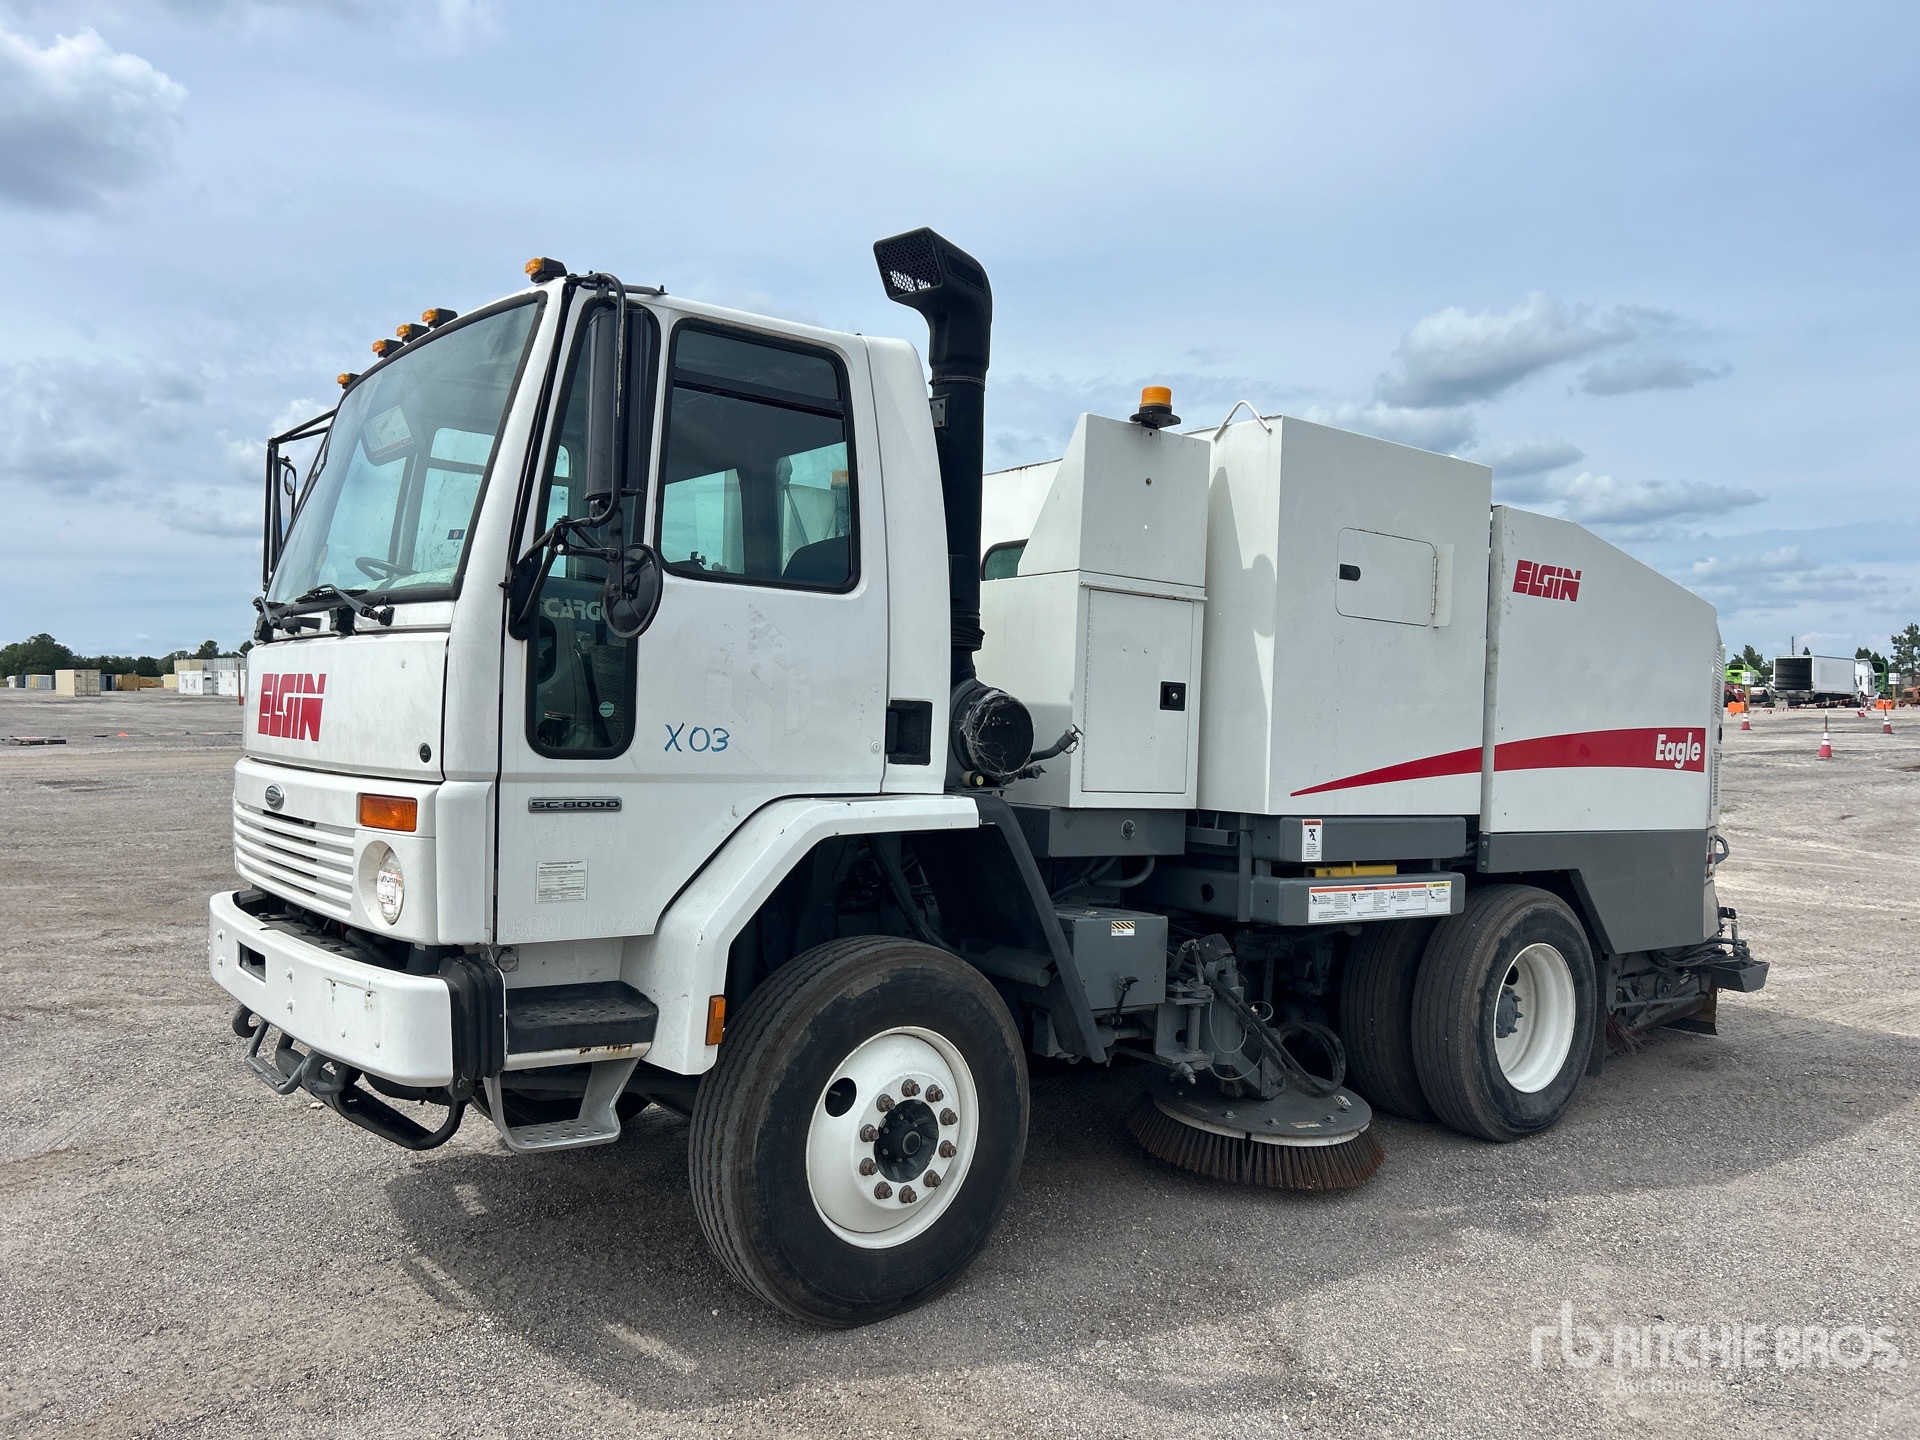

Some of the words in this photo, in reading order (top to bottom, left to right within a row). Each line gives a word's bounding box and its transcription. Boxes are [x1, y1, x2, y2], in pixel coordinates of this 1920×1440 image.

[1512, 559, 1582, 602] ELGIN
[543, 598, 607, 621] CARG
[257, 673, 327, 742] ELGIN
[1655, 732, 1701, 769] Eagle
[531, 801, 620, 809] SC-8000
